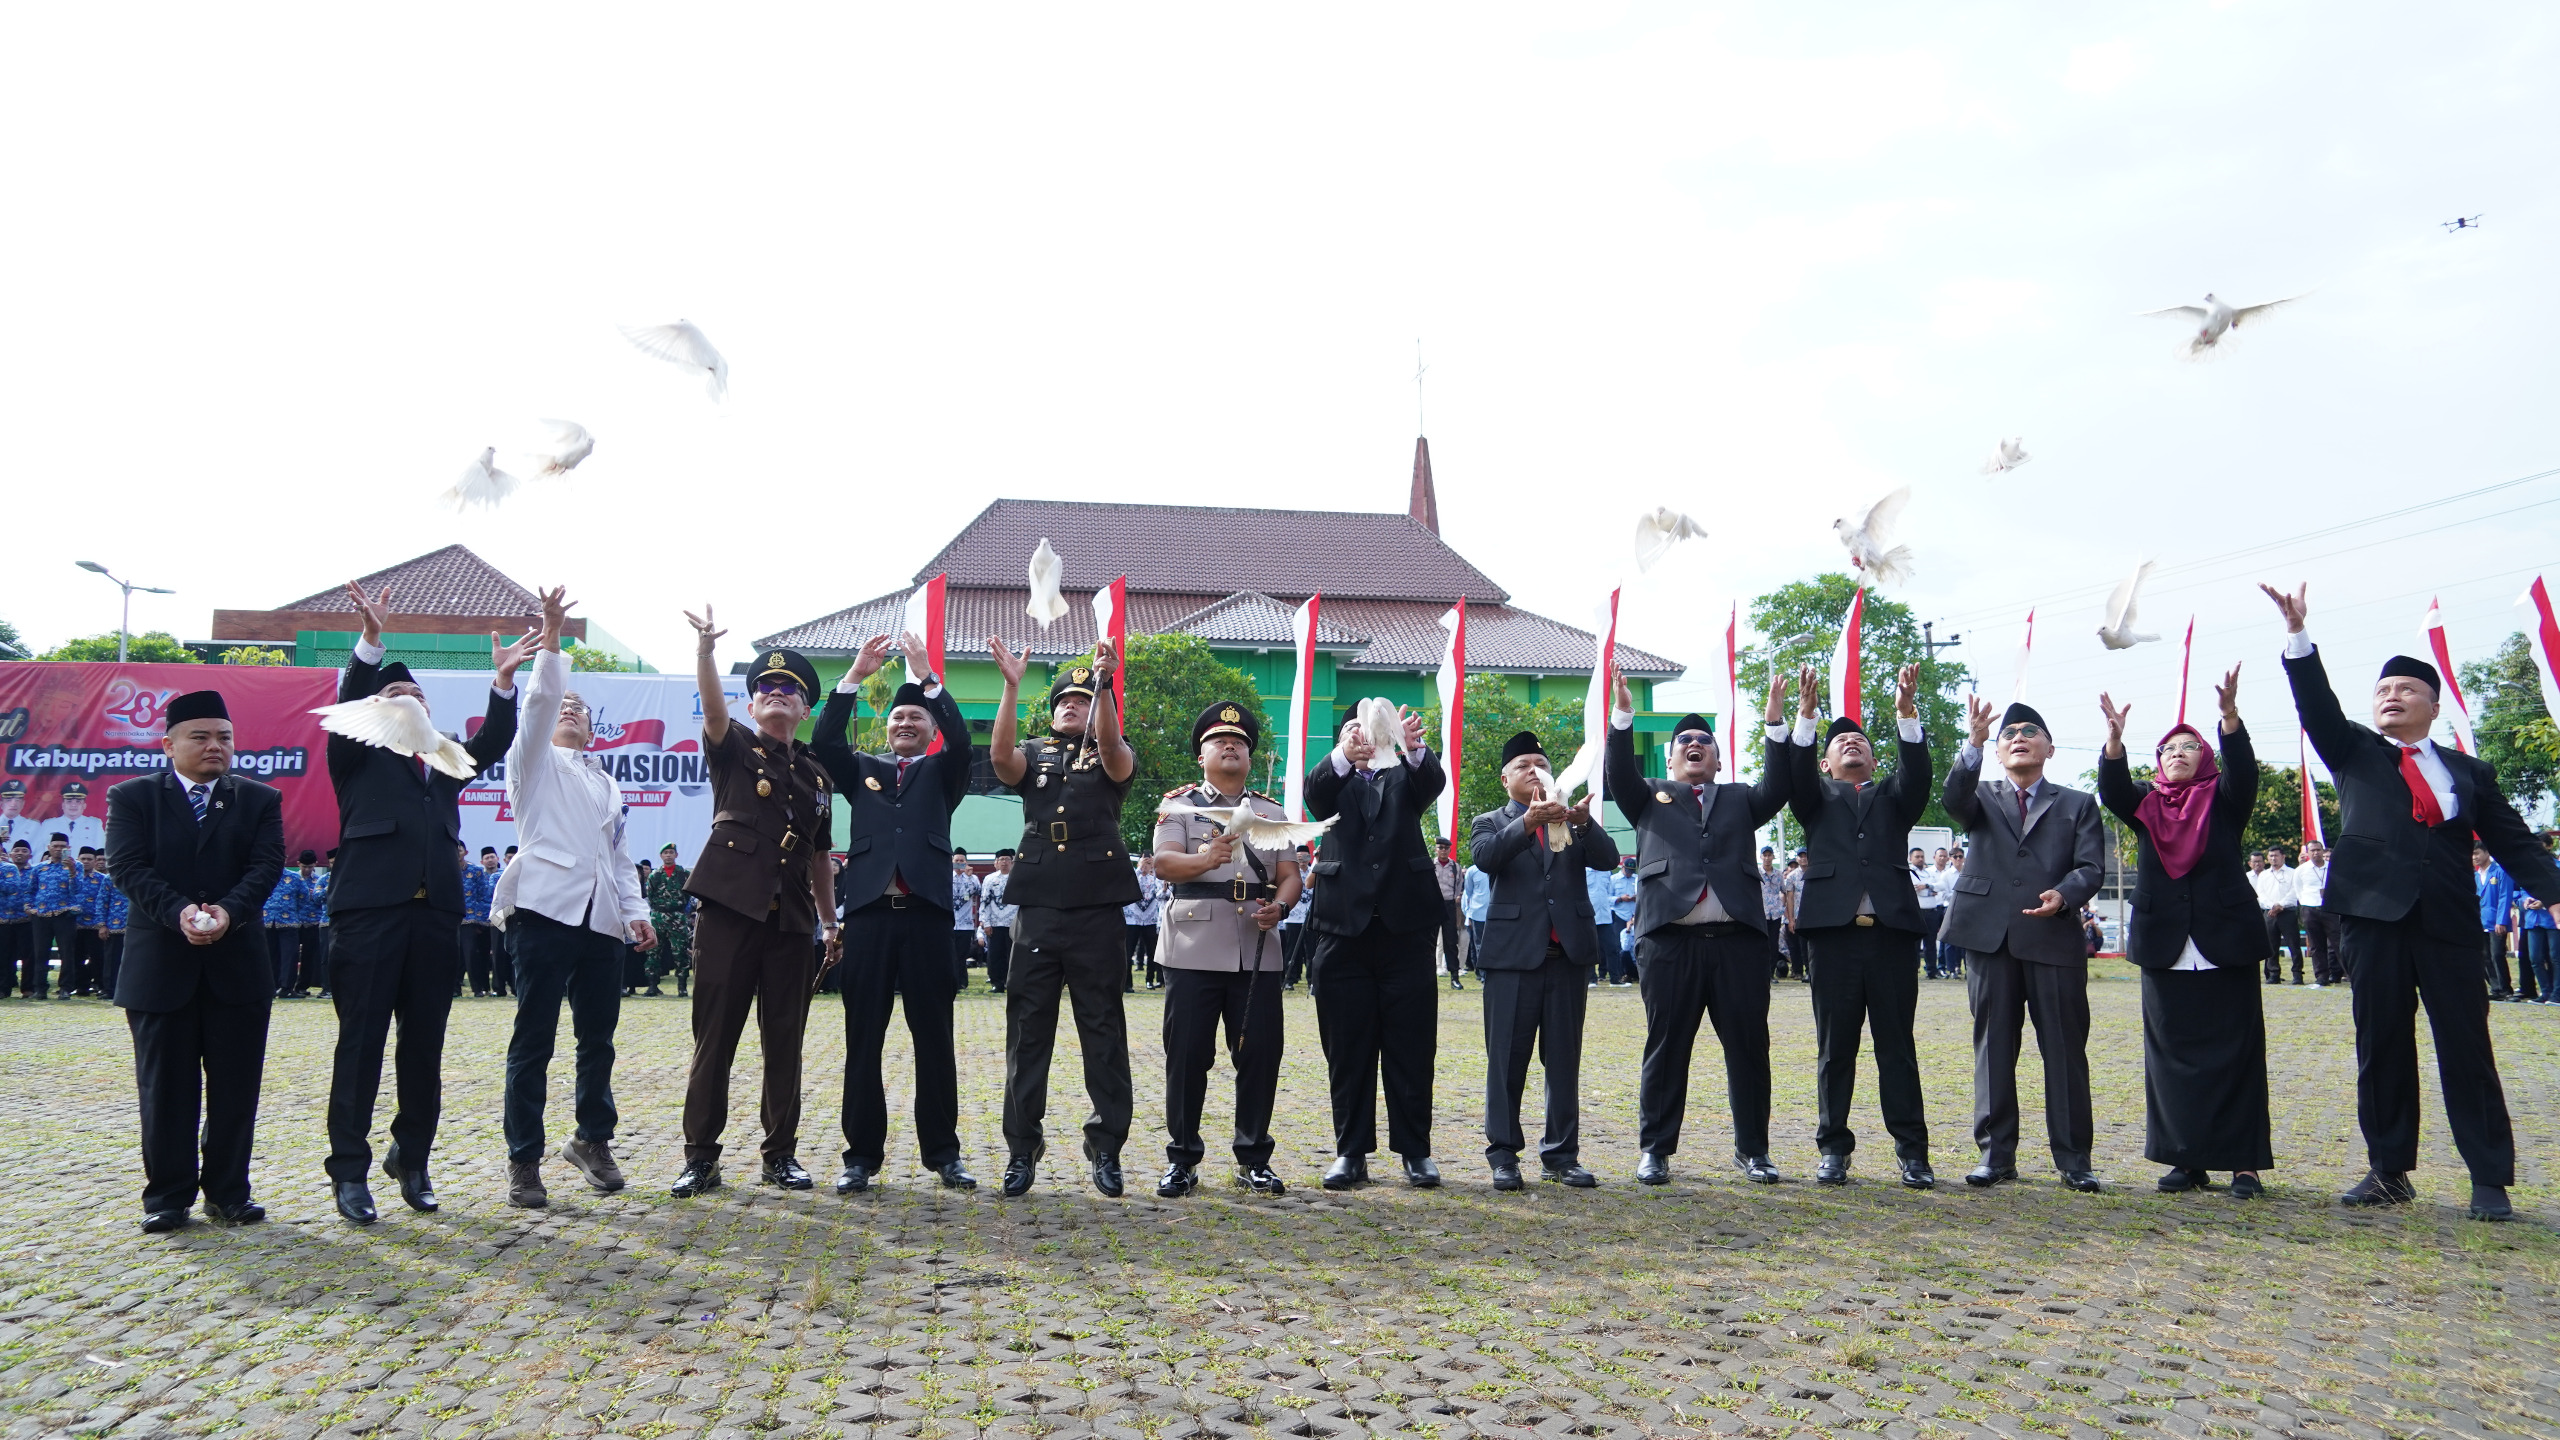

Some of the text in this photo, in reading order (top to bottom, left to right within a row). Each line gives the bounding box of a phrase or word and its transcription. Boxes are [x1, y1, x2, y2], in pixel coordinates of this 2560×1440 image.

[13, 750, 168, 773] Kabupaten
[465, 792, 502, 802] BANGKIT
[642, 793, 666, 803] KUAT
